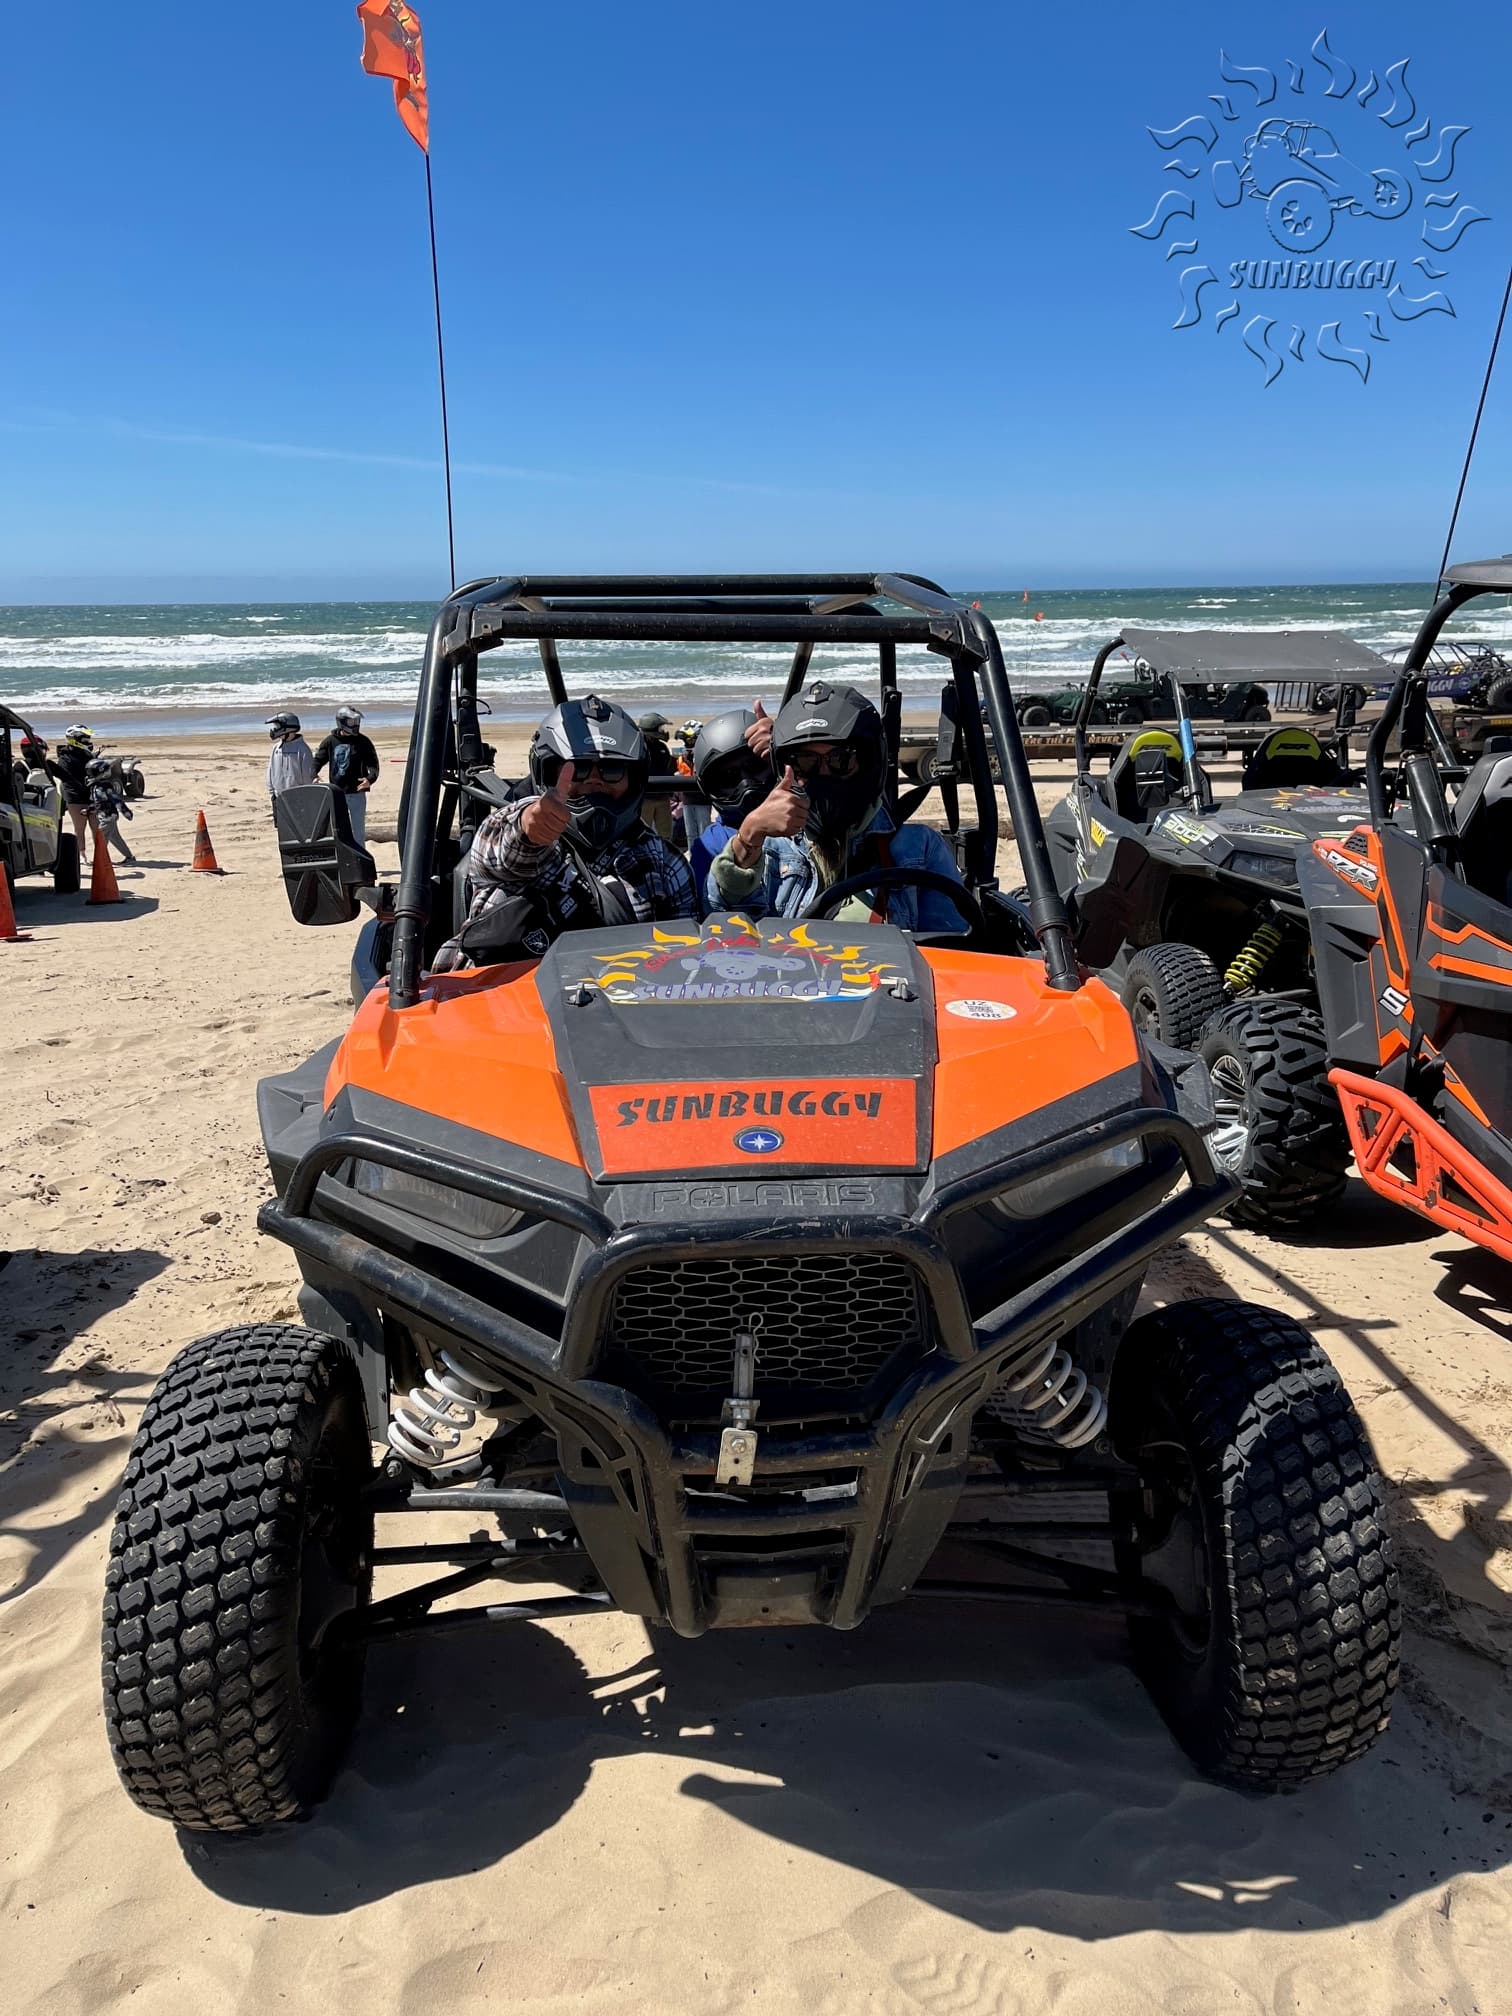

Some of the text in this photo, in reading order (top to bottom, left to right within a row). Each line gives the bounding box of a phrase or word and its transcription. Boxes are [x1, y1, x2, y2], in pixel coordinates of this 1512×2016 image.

[1427, 679, 1454, 694] GGY
[1326, 849, 1380, 892] RZR
[632, 979, 844, 999] SUNBUGGY
[616, 1090, 883, 1127] SUNBUGGY
[653, 1183, 875, 1213] POLARIS
